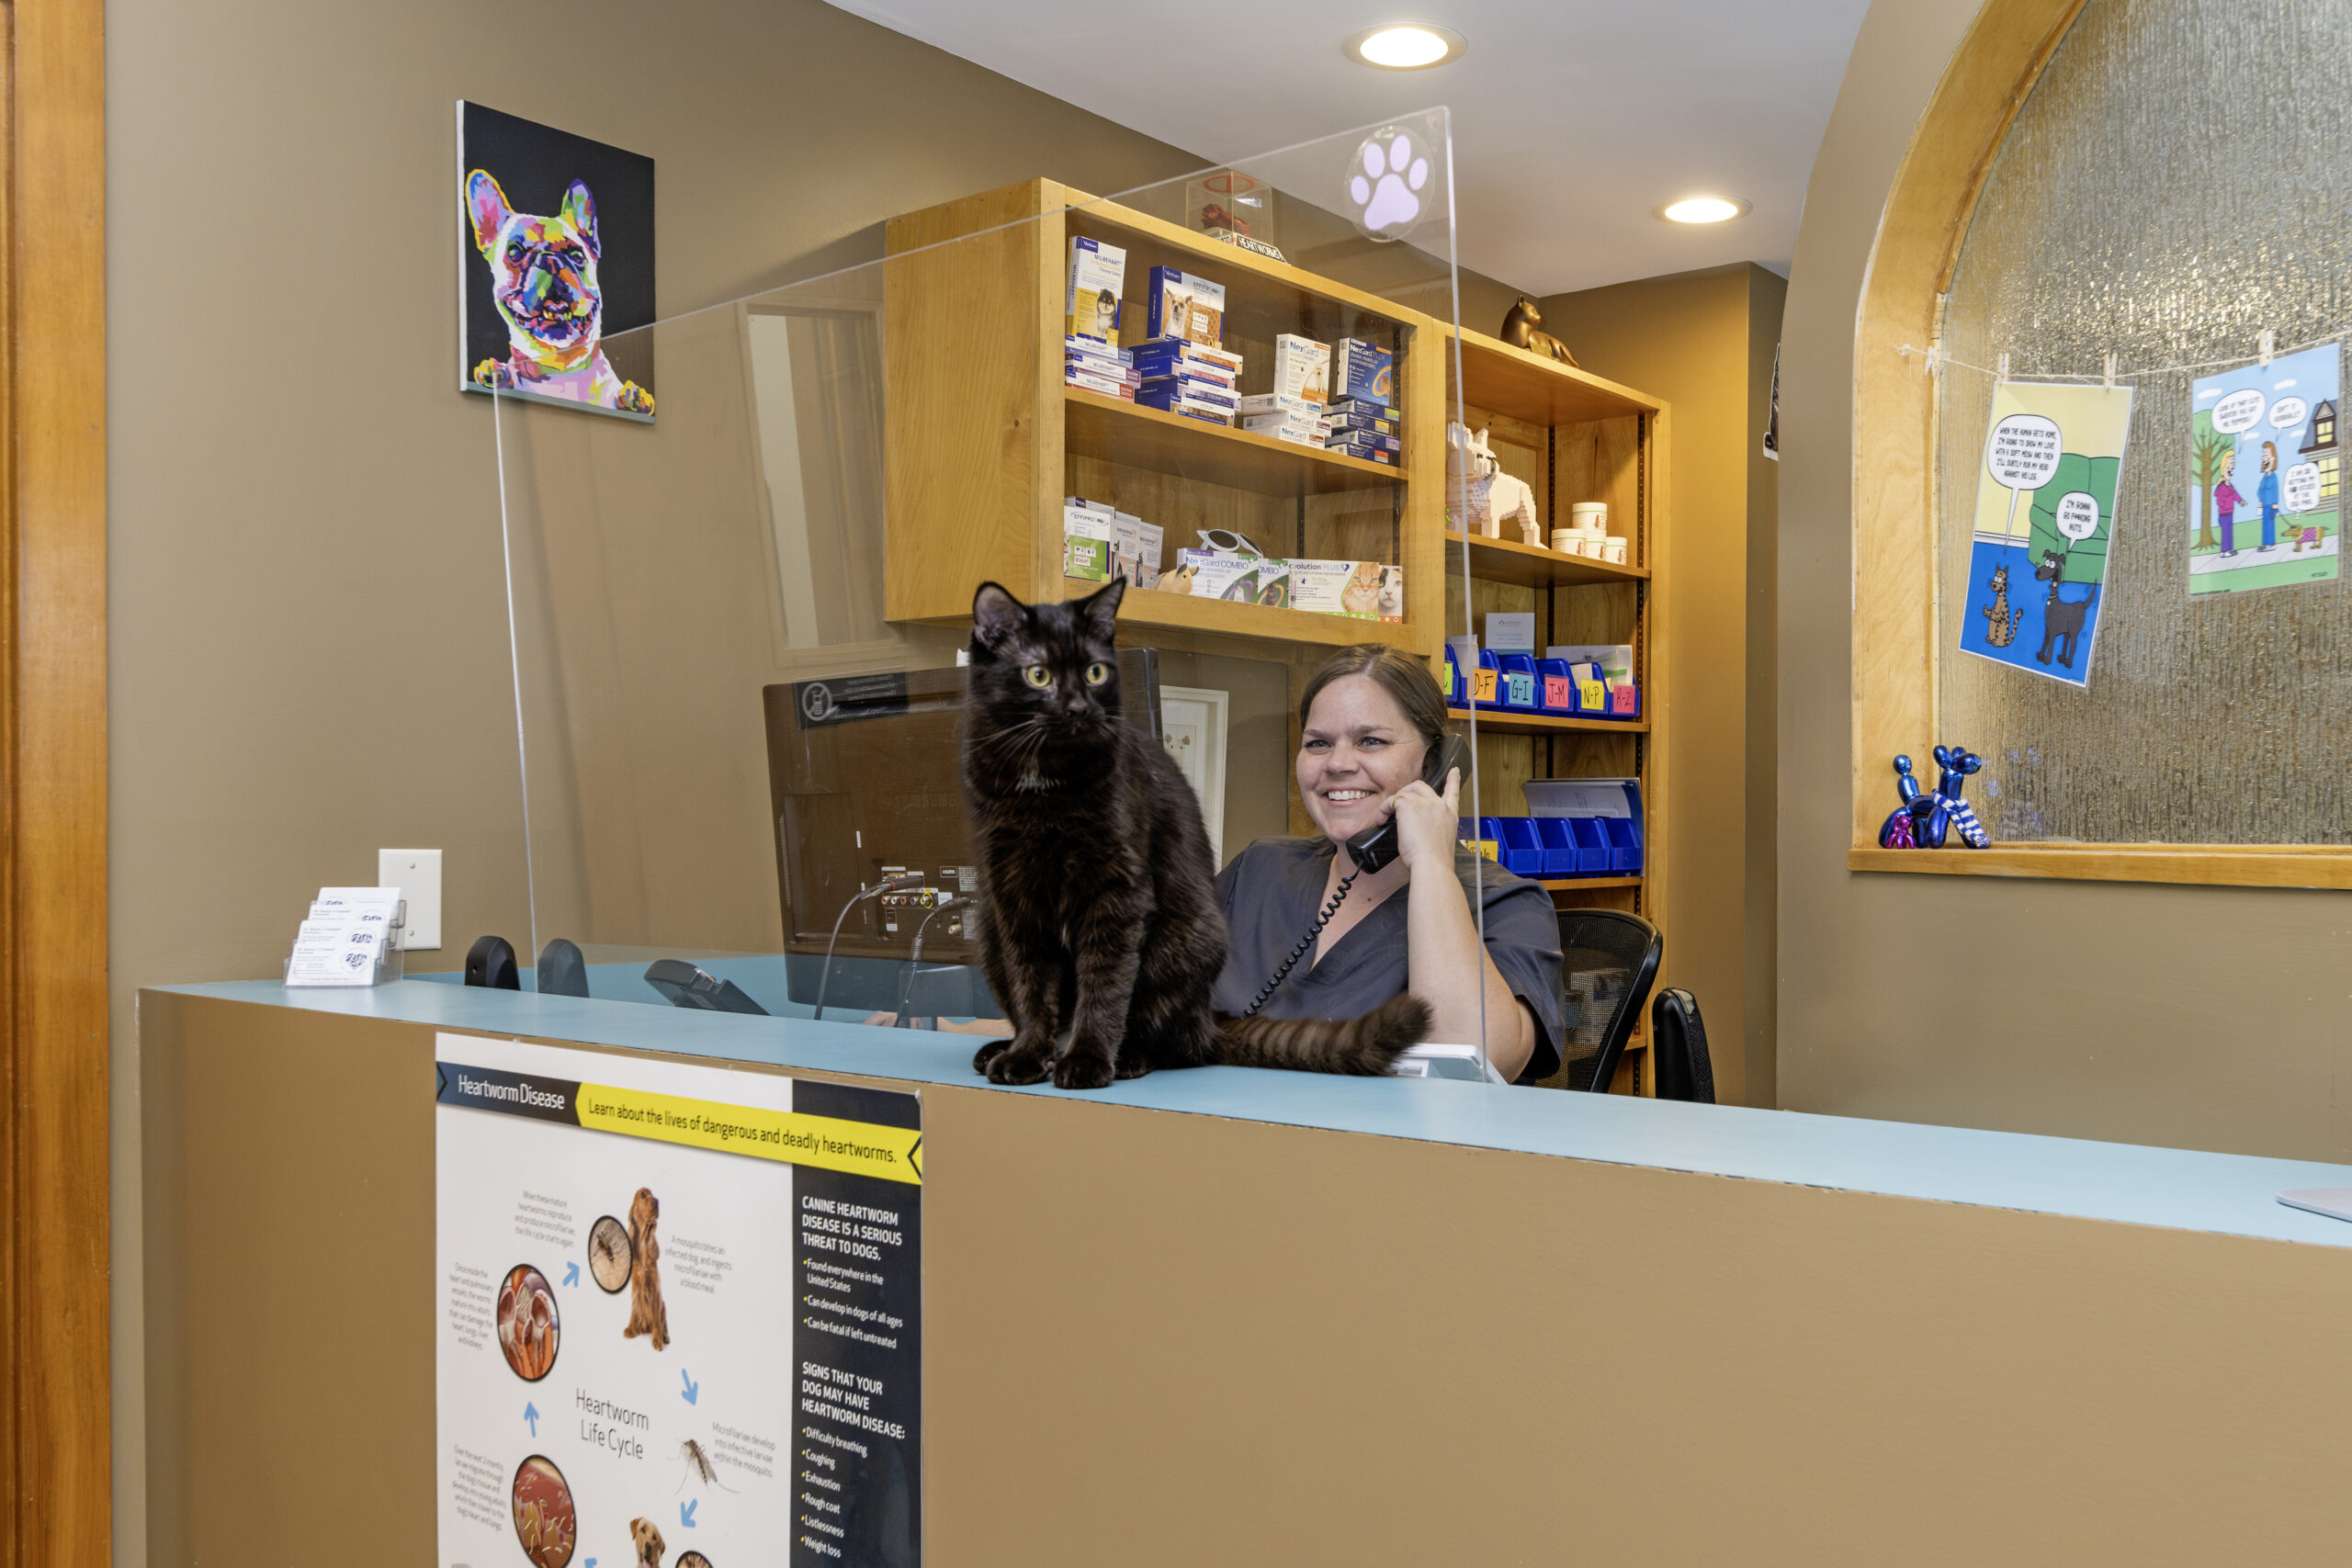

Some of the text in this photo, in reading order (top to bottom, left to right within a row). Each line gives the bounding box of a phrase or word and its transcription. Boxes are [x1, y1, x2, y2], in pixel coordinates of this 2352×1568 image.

[1290, 341, 1318, 357] NexGard
[1350, 344, 1373, 356] NexGard
[1280, 396, 1304, 409] NexGard
[1290, 414, 1314, 427] NexGard
[1282, 427, 1306, 440] NexGard
[1220, 559, 1249, 570] COMBO
[1473, 672, 1494, 695] D-F
[1511, 678, 1529, 702] G-I
[1547, 682, 1566, 704] J-M
[1583, 687, 1600, 705] N-P
[1615, 688, 1632, 706] R-Z
[458, 1073, 565, 1110] Heartworm Disease
[589, 1100, 898, 1164] Learn about the lives of dangerous and deadly heartworms.
[802, 1196, 899, 1226] CANINE HEARTWORM
[802, 1213, 902, 1246] DISEASE IS A SERIOUS
[802, 1232, 837, 1251] THREAT
[838, 1239, 851, 1254] TO
[807, 1258, 884, 1285] Found everywhere in the
[807, 1273, 851, 1292] United States
[808, 1294, 903, 1329] Can develop in dogs of all ages
[808, 1316, 897, 1349] Can be fatal if left untreated
[802, 1361, 883, 1395] SIGNS THAT YOUR
[802, 1380, 870, 1411] DOG MAY HAVE
[576, 1387, 649, 1431] Heartworm
[802, 1397, 906, 1439] HEARTWORM DISEASE:
[581, 1418, 644, 1460] Life Cycle
[806, 1426, 867, 1459] Difficulty breathing
[805, 1449, 835, 1471] Coughing
[805, 1470, 841, 1492] Exhaustion
[805, 1492, 841, 1515] Rough coat
[805, 1514, 844, 1538] Listlessness
[804, 1535, 842, 1559] Weight loss
